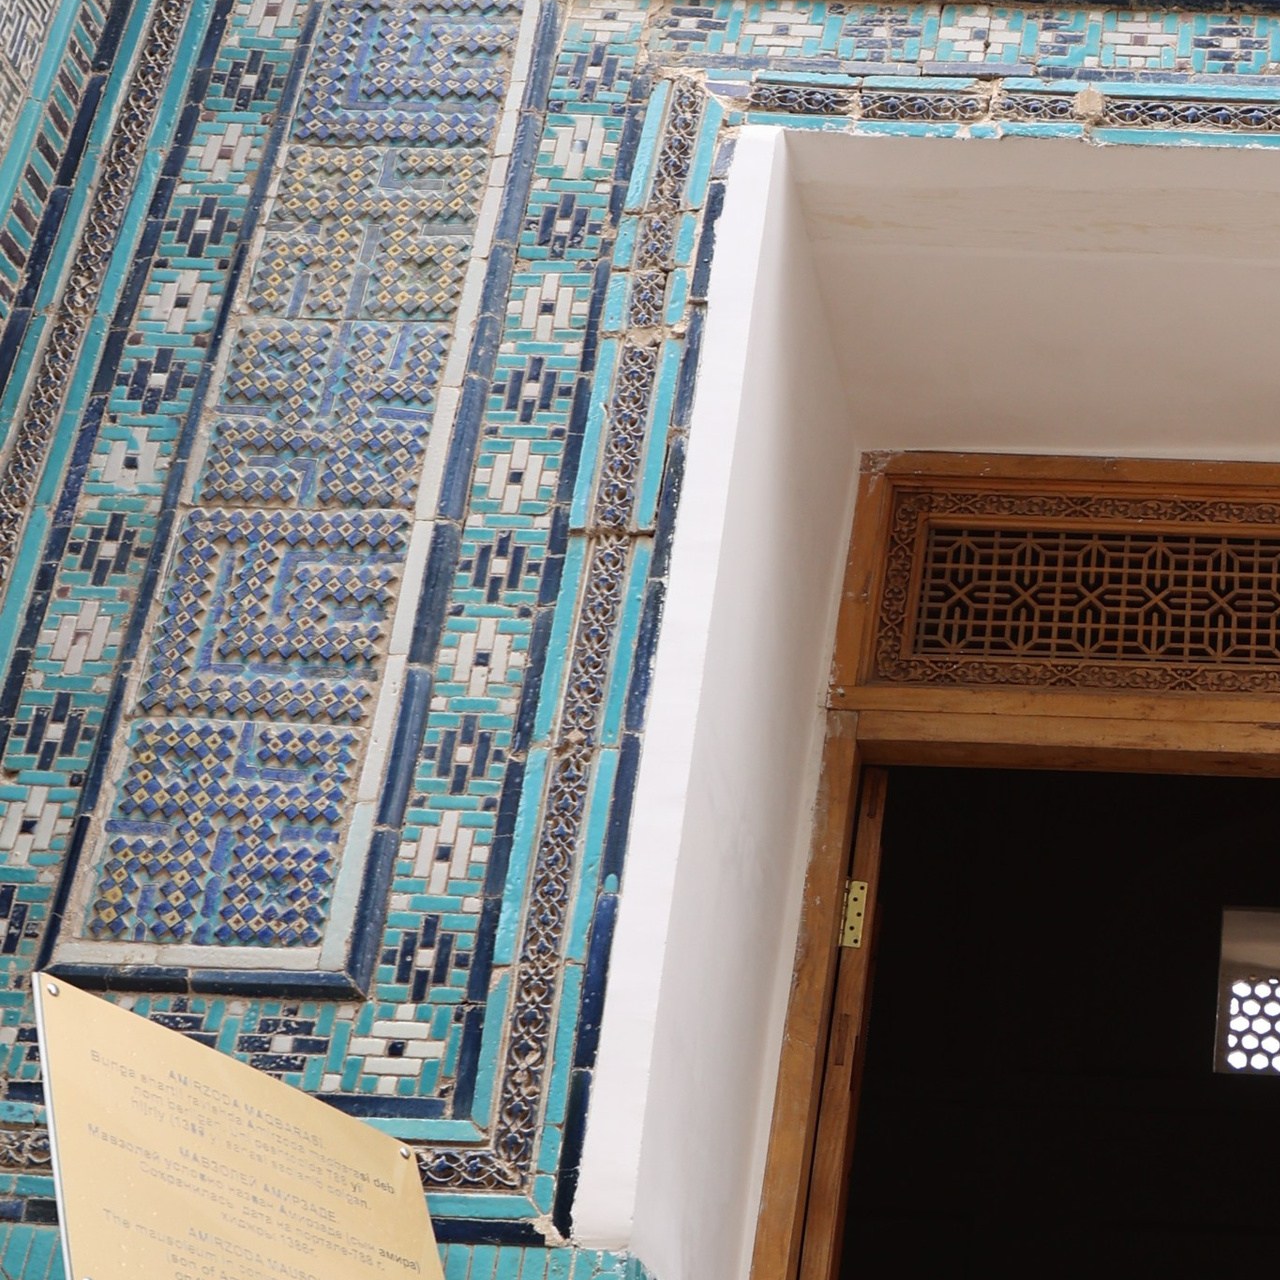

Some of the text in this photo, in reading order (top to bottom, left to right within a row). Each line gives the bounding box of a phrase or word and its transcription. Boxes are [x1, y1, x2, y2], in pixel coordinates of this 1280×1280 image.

[168, 1068, 240, 1110] AMIRZODA
[90, 1048, 136, 1082] Bunga
[372, 1176, 396, 1195] deb
[179, 1145, 258, 1190] МАВЗОЛЕЙ
[88, 1122, 161, 1165] Мавзолей
[377, 1245, 422, 1275] амира)
[103, 1207, 131, 1231] The
[135, 1220, 217, 1264] mausoleum
[187, 1225, 264, 1267] AMIRZODA
